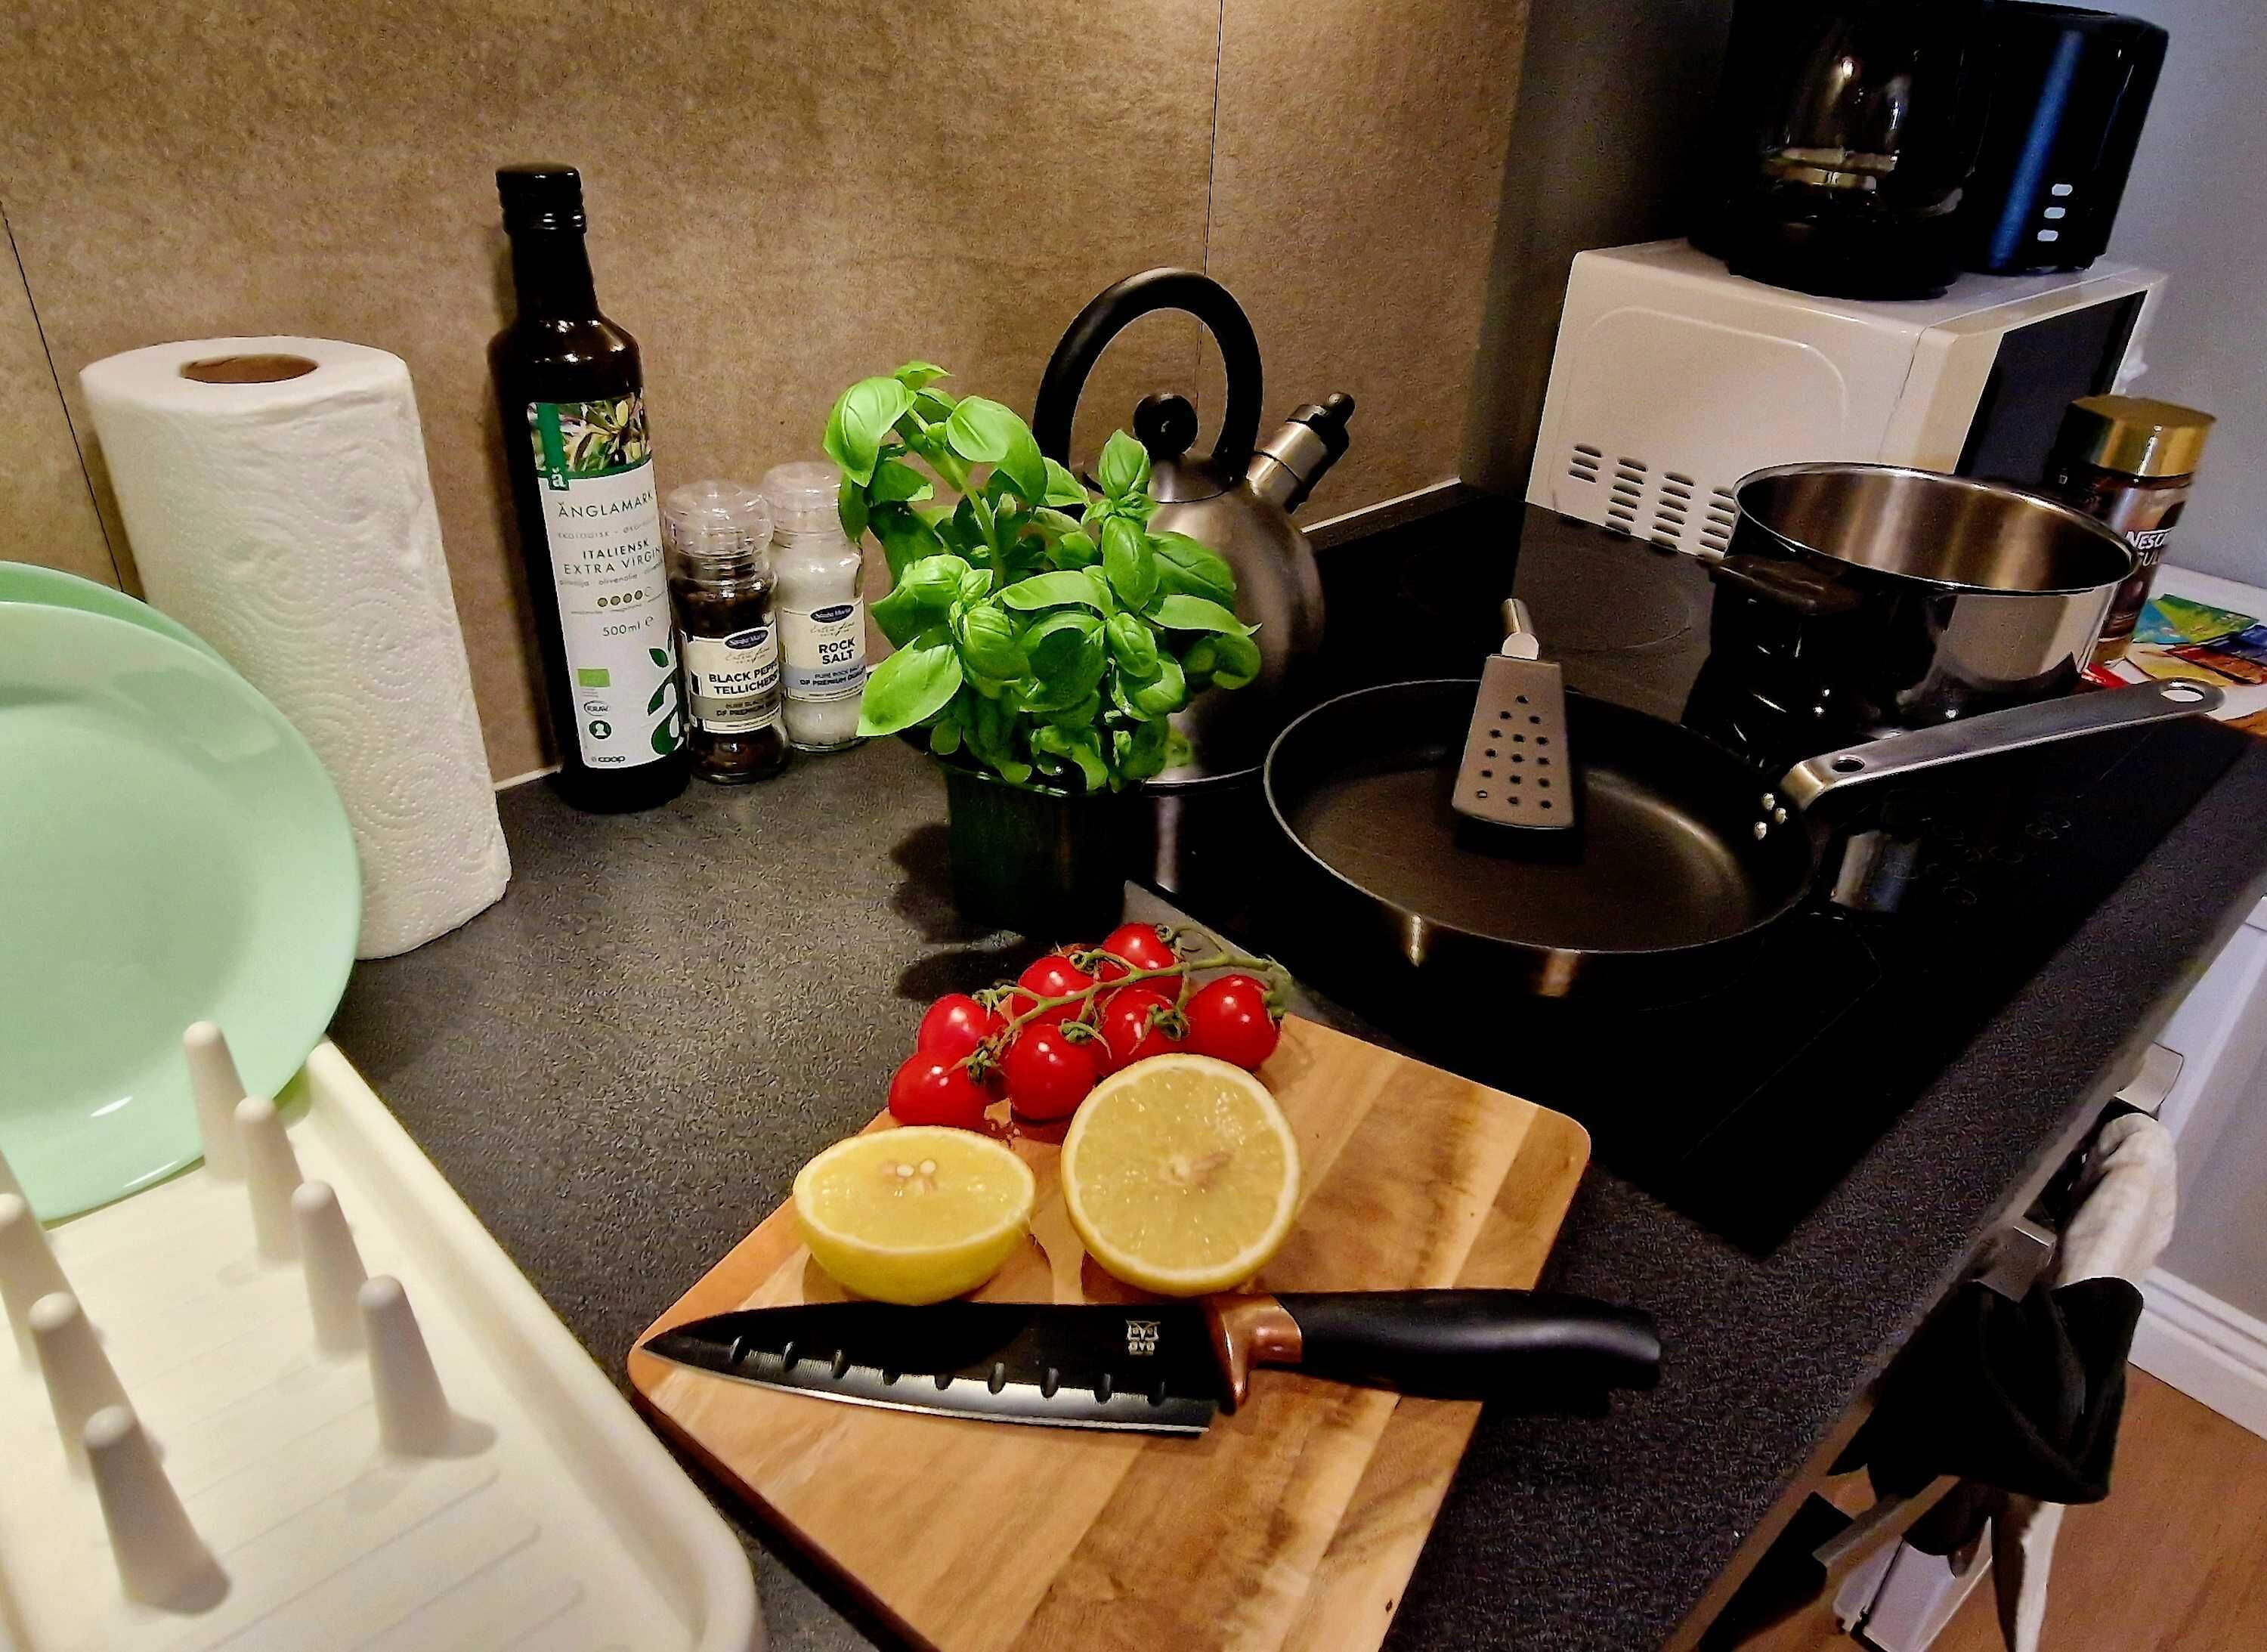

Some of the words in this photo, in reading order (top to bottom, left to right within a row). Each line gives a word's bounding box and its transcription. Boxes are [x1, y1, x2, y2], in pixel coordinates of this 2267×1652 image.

[583, 539, 649, 559] ITALIENSK
[564, 563, 615, 575] EXTRA
[621, 546, 660, 568] VIRGIN
[602, 621, 641, 636] 500ml
[818, 636, 855, 654] ROCK
[822, 649, 855, 665] SALT
[709, 671, 751, 683] BLACK
